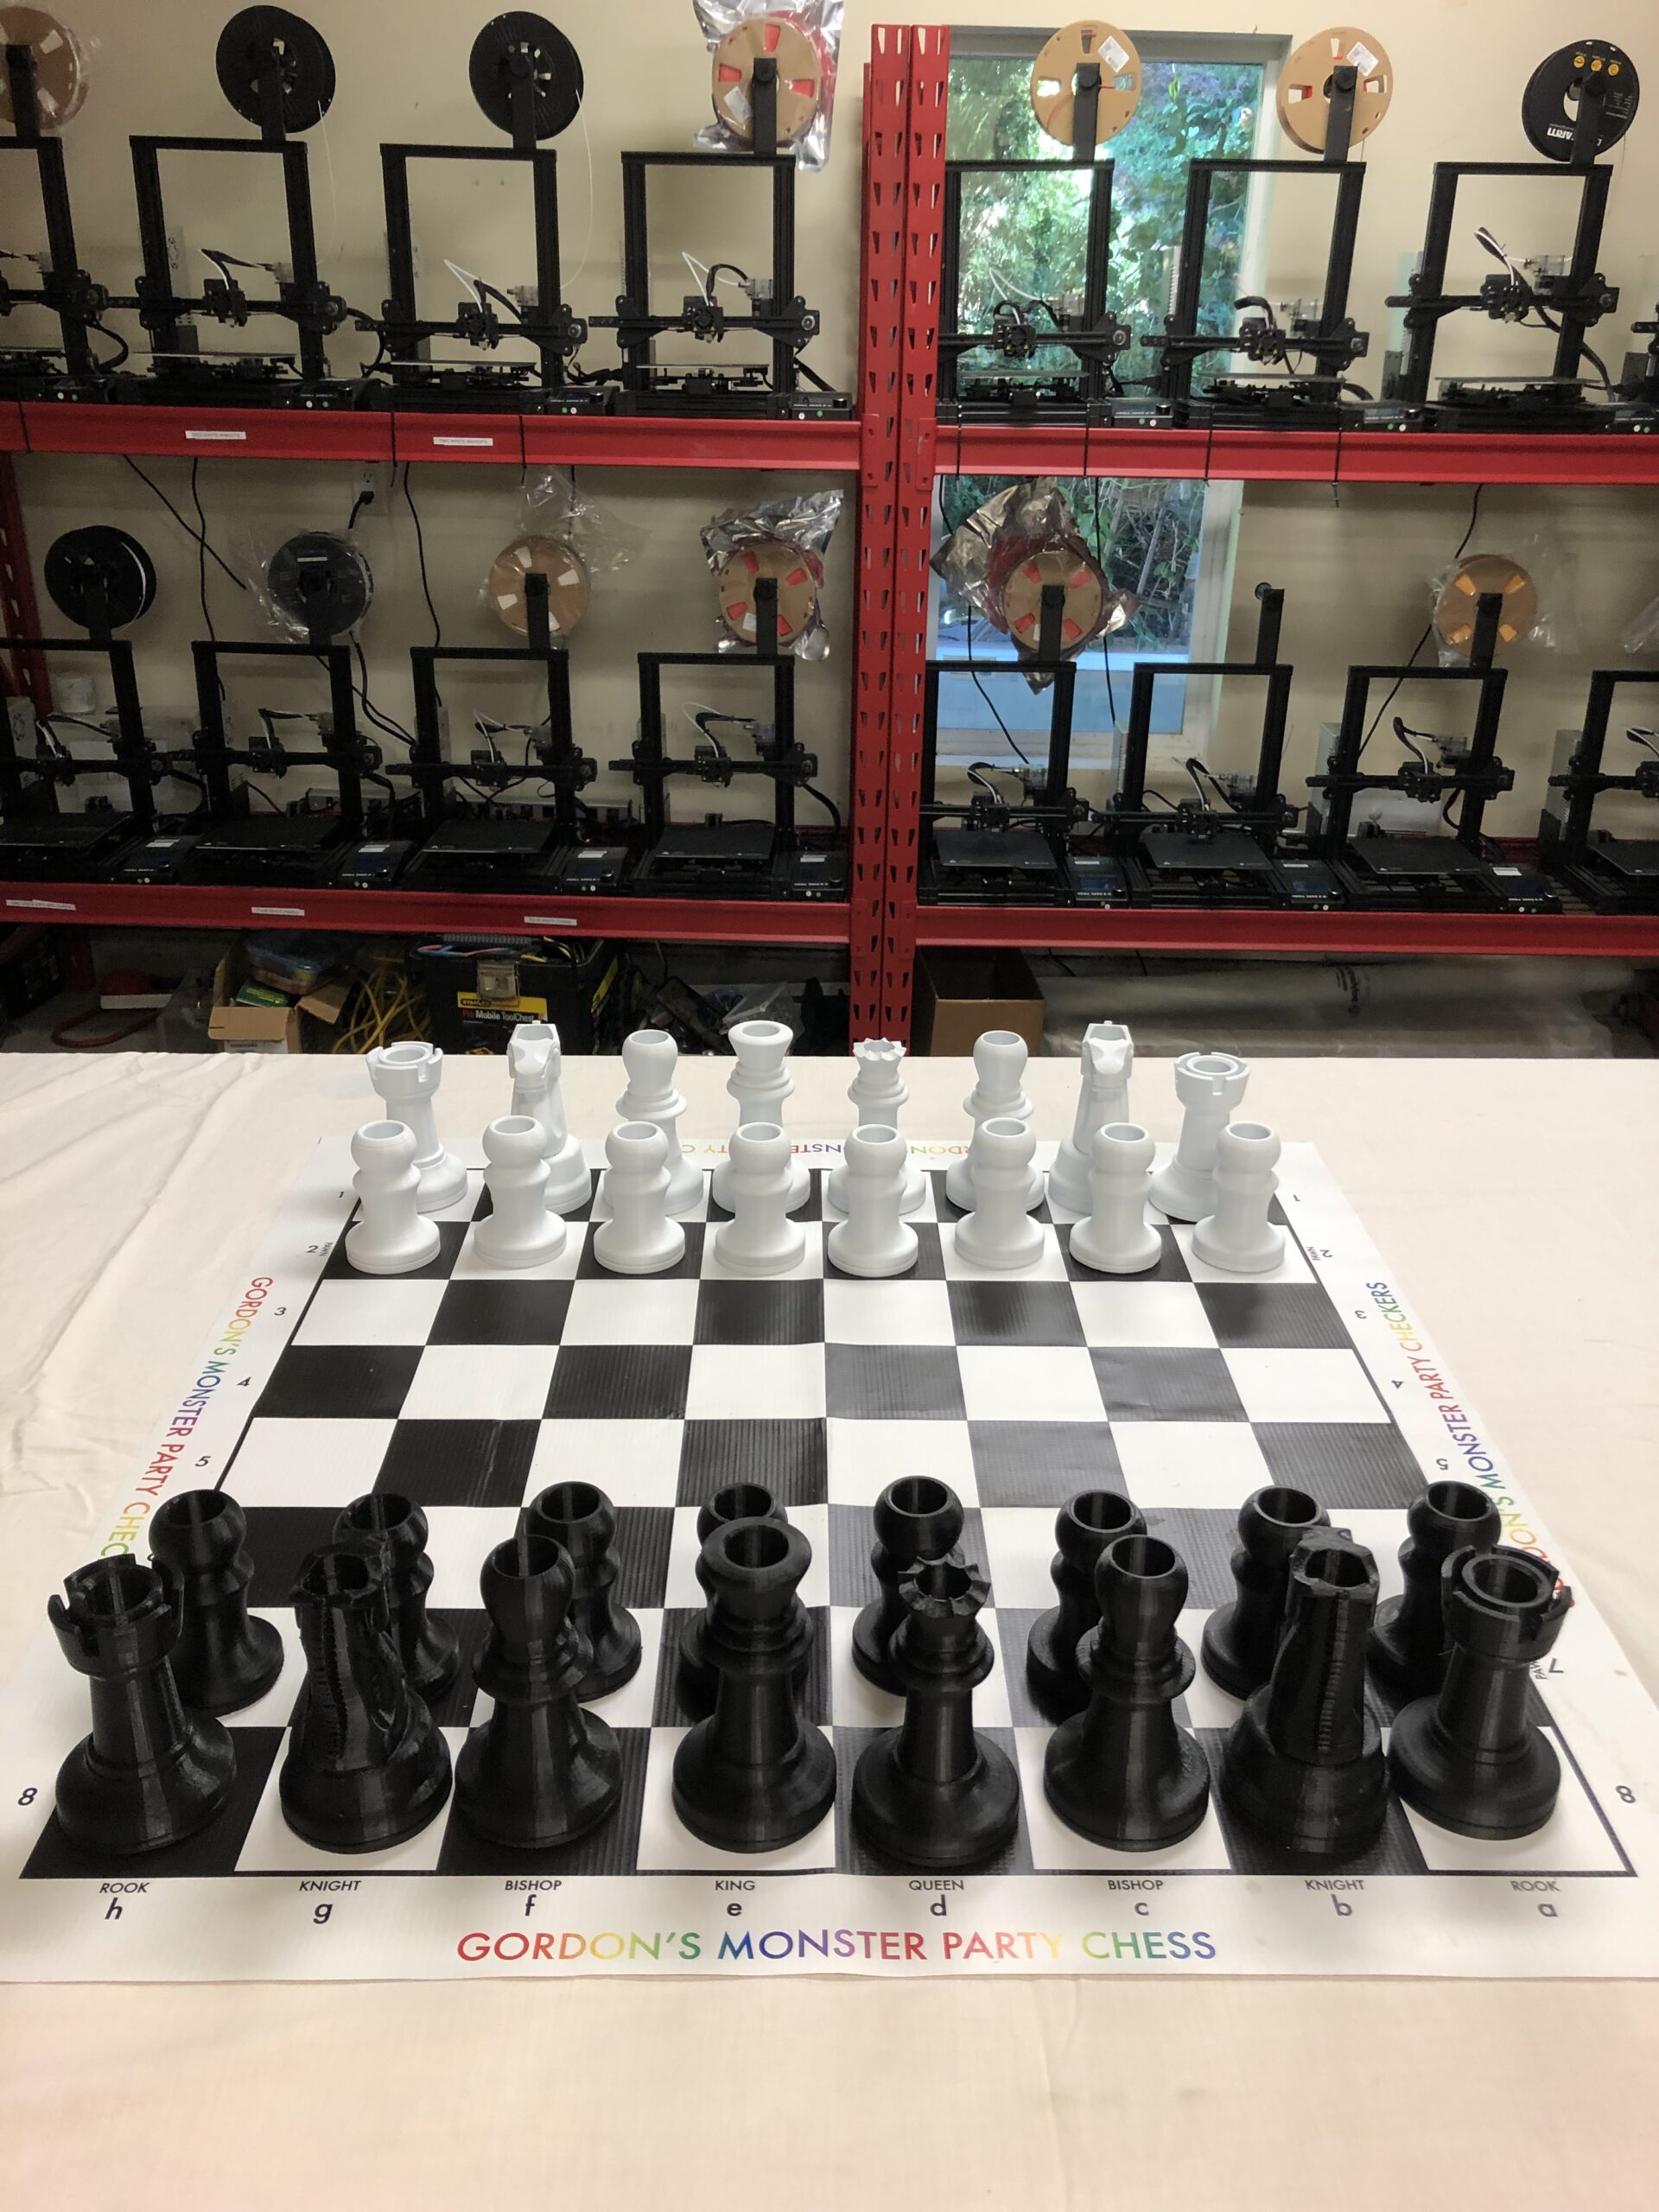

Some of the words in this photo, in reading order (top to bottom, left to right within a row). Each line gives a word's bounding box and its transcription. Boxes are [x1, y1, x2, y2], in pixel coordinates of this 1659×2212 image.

[476, 1009, 501, 1020] Mobile
[502, 1011, 535, 1023] ToolChest
[791, 1143, 842, 1154] NSTE
[306, 1244, 319, 1254] 2
[1319, 1249, 1333, 1259] 2
[213, 1276, 274, 1356] GORDON'S
[273, 1306, 288, 1316] 3
[1354, 1309, 1368, 1319] 3
[1365, 1281, 1423, 1352] CHECKERS
[236, 1376, 252, 1387] 4
[1390, 1379, 1404, 1389] 4
[1407, 1355, 1454, 1400] PARTY
[165, 1360, 231, 1438] MONSTER
[1438, 1404, 1506, 1490] MONSTER
[194, 1455, 212, 1467] 5
[1435, 1458, 1449, 1470] 5
[135, 1443, 186, 1497] PARTY
[100, 1501, 151, 1556] CHEC
[1529, 1661, 1548, 1680] PAW
[1548, 1657, 1565, 1674] 7
[17, 1787, 39, 1807] 8
[1615, 1784, 1637, 1804] 8
[99, 1881, 150, 1894] ROOK
[299, 1879, 362, 1892] KNIGHT
[505, 1879, 563, 1891] BISHOP
[715, 1879, 758, 1891] KING
[908, 1879, 965, 1891] QUEEN
[1107, 1879, 1165, 1891] BISHOP
[1304, 1878, 1365, 1891] KNIGHT
[1510, 1880, 1560, 1893] ROOK
[104, 1897, 124, 1921] h
[312, 1901, 334, 1924] g
[524, 1894, 537, 1917] f
[727, 1901, 743, 1917] e
[929, 1895, 948, 1916] d
[1134, 1902, 1150, 1917] c
[1333, 1895, 1353, 1916] b
[1537, 1902, 1559, 1917] a
[456, 1929, 703, 1963] GORDON'S
[716, 1929, 928, 1962] MONSTER
[942, 1930, 1064, 1961] PARTY
[1080, 1929, 1217, 1961] CHESS
